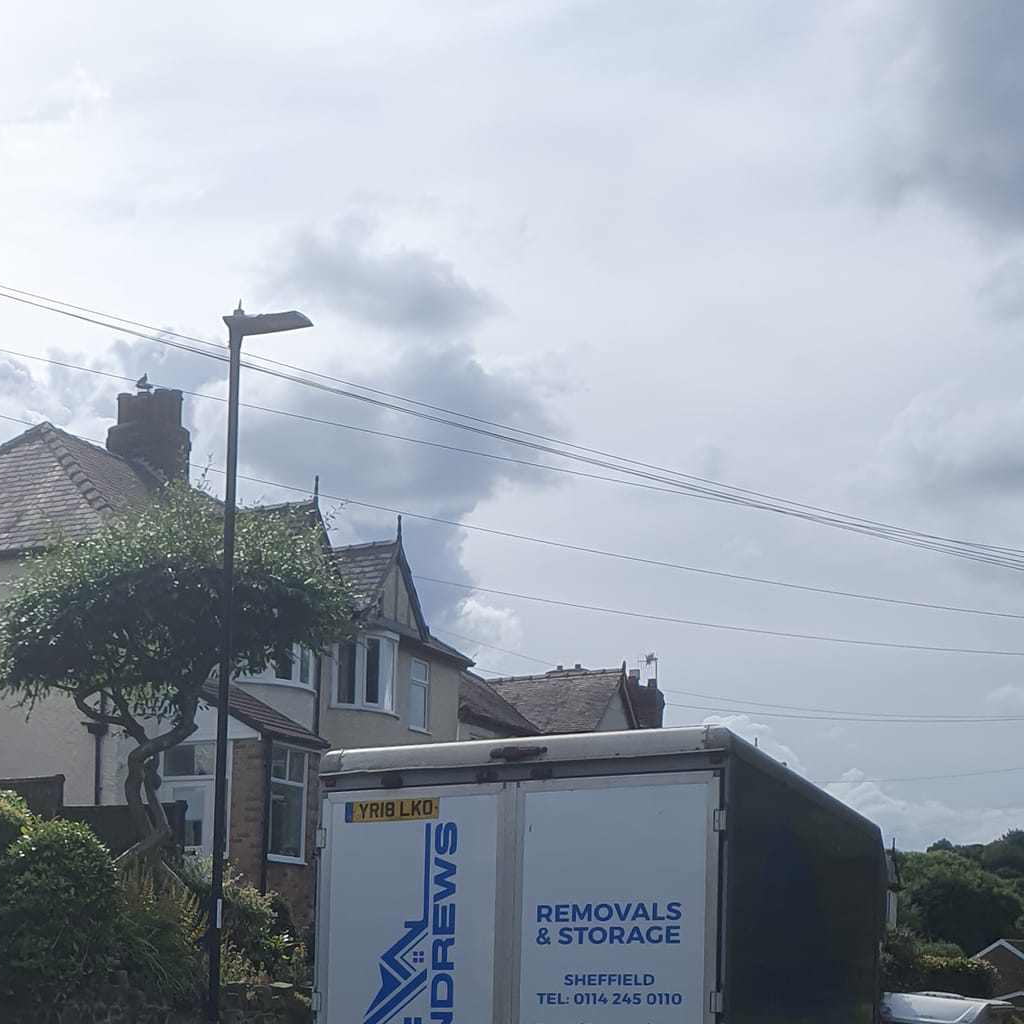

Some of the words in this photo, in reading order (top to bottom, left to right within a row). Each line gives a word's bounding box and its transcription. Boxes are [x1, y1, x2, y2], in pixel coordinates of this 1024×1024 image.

[359, 802, 395, 819] YR18
[536, 902, 682, 923] REMOVALS
[535, 927, 551, 945] &
[558, 925, 681, 945] STORAGE
[563, 973, 655, 986] SHEFFIELD
[537, 993, 570, 1005] TEL:
[573, 993, 608, 1005] 0114
[612, 993, 642, 1005] 245
[646, 993, 682, 1005] 0110
